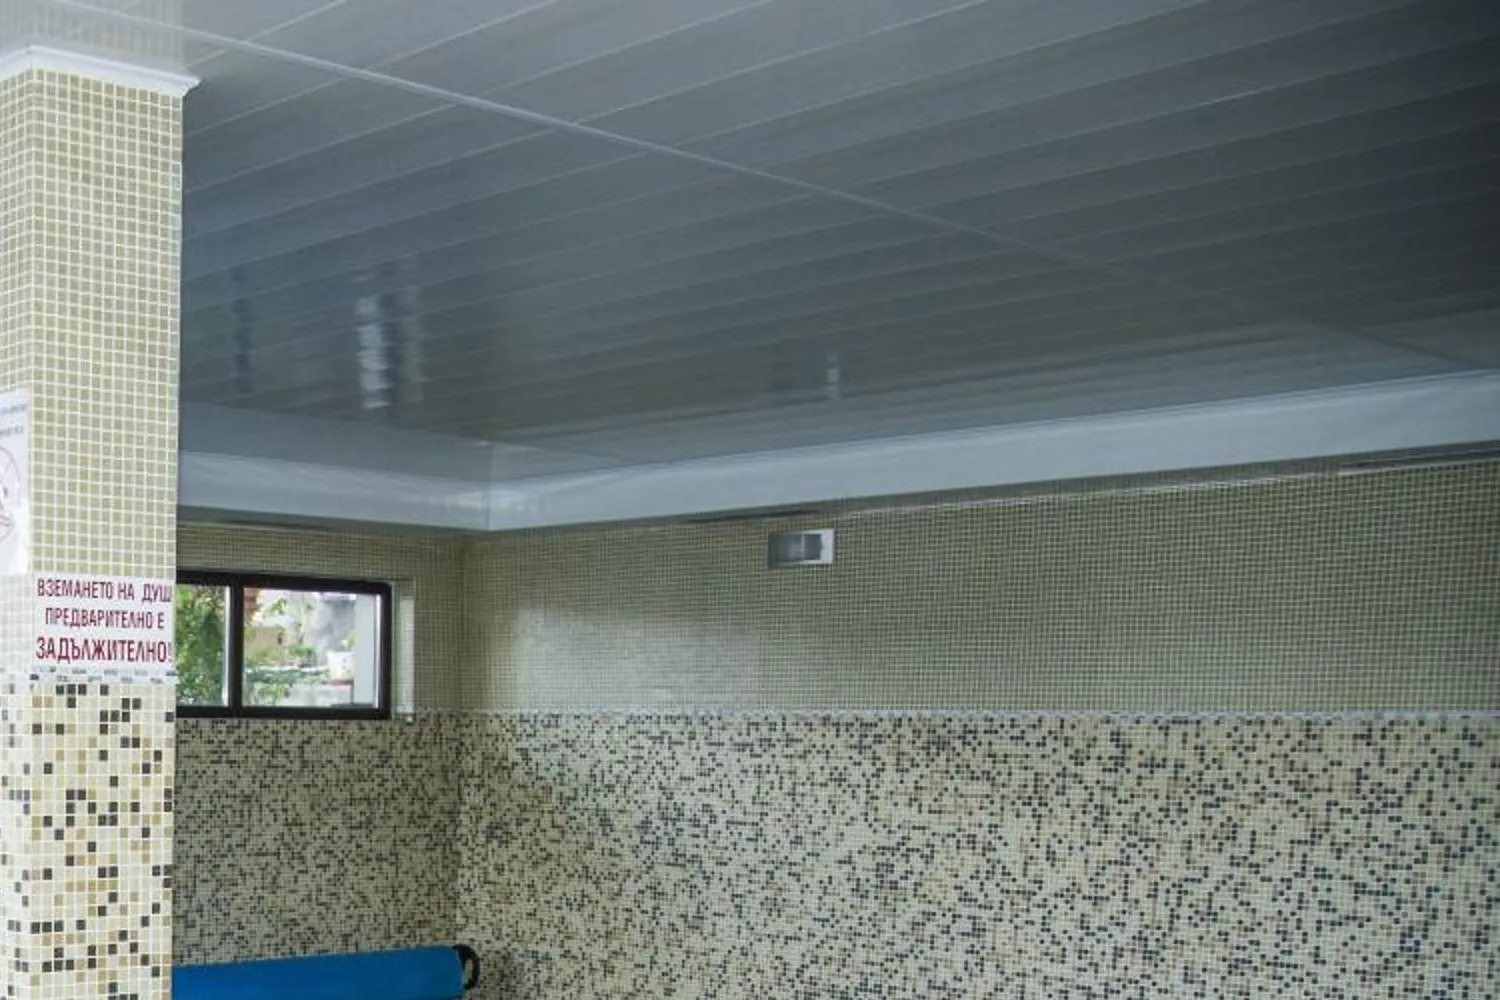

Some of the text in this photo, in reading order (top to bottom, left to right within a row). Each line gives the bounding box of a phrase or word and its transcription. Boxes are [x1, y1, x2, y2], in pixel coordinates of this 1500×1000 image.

[37, 578, 173, 604] ВЗЕМАНЕТО НА ДУШ
[45, 607, 165, 629] ПРЕДВАРИТЕЛНО Е
[36, 637, 173, 663] ЗАДЪЛЖИТЕЛНО!
